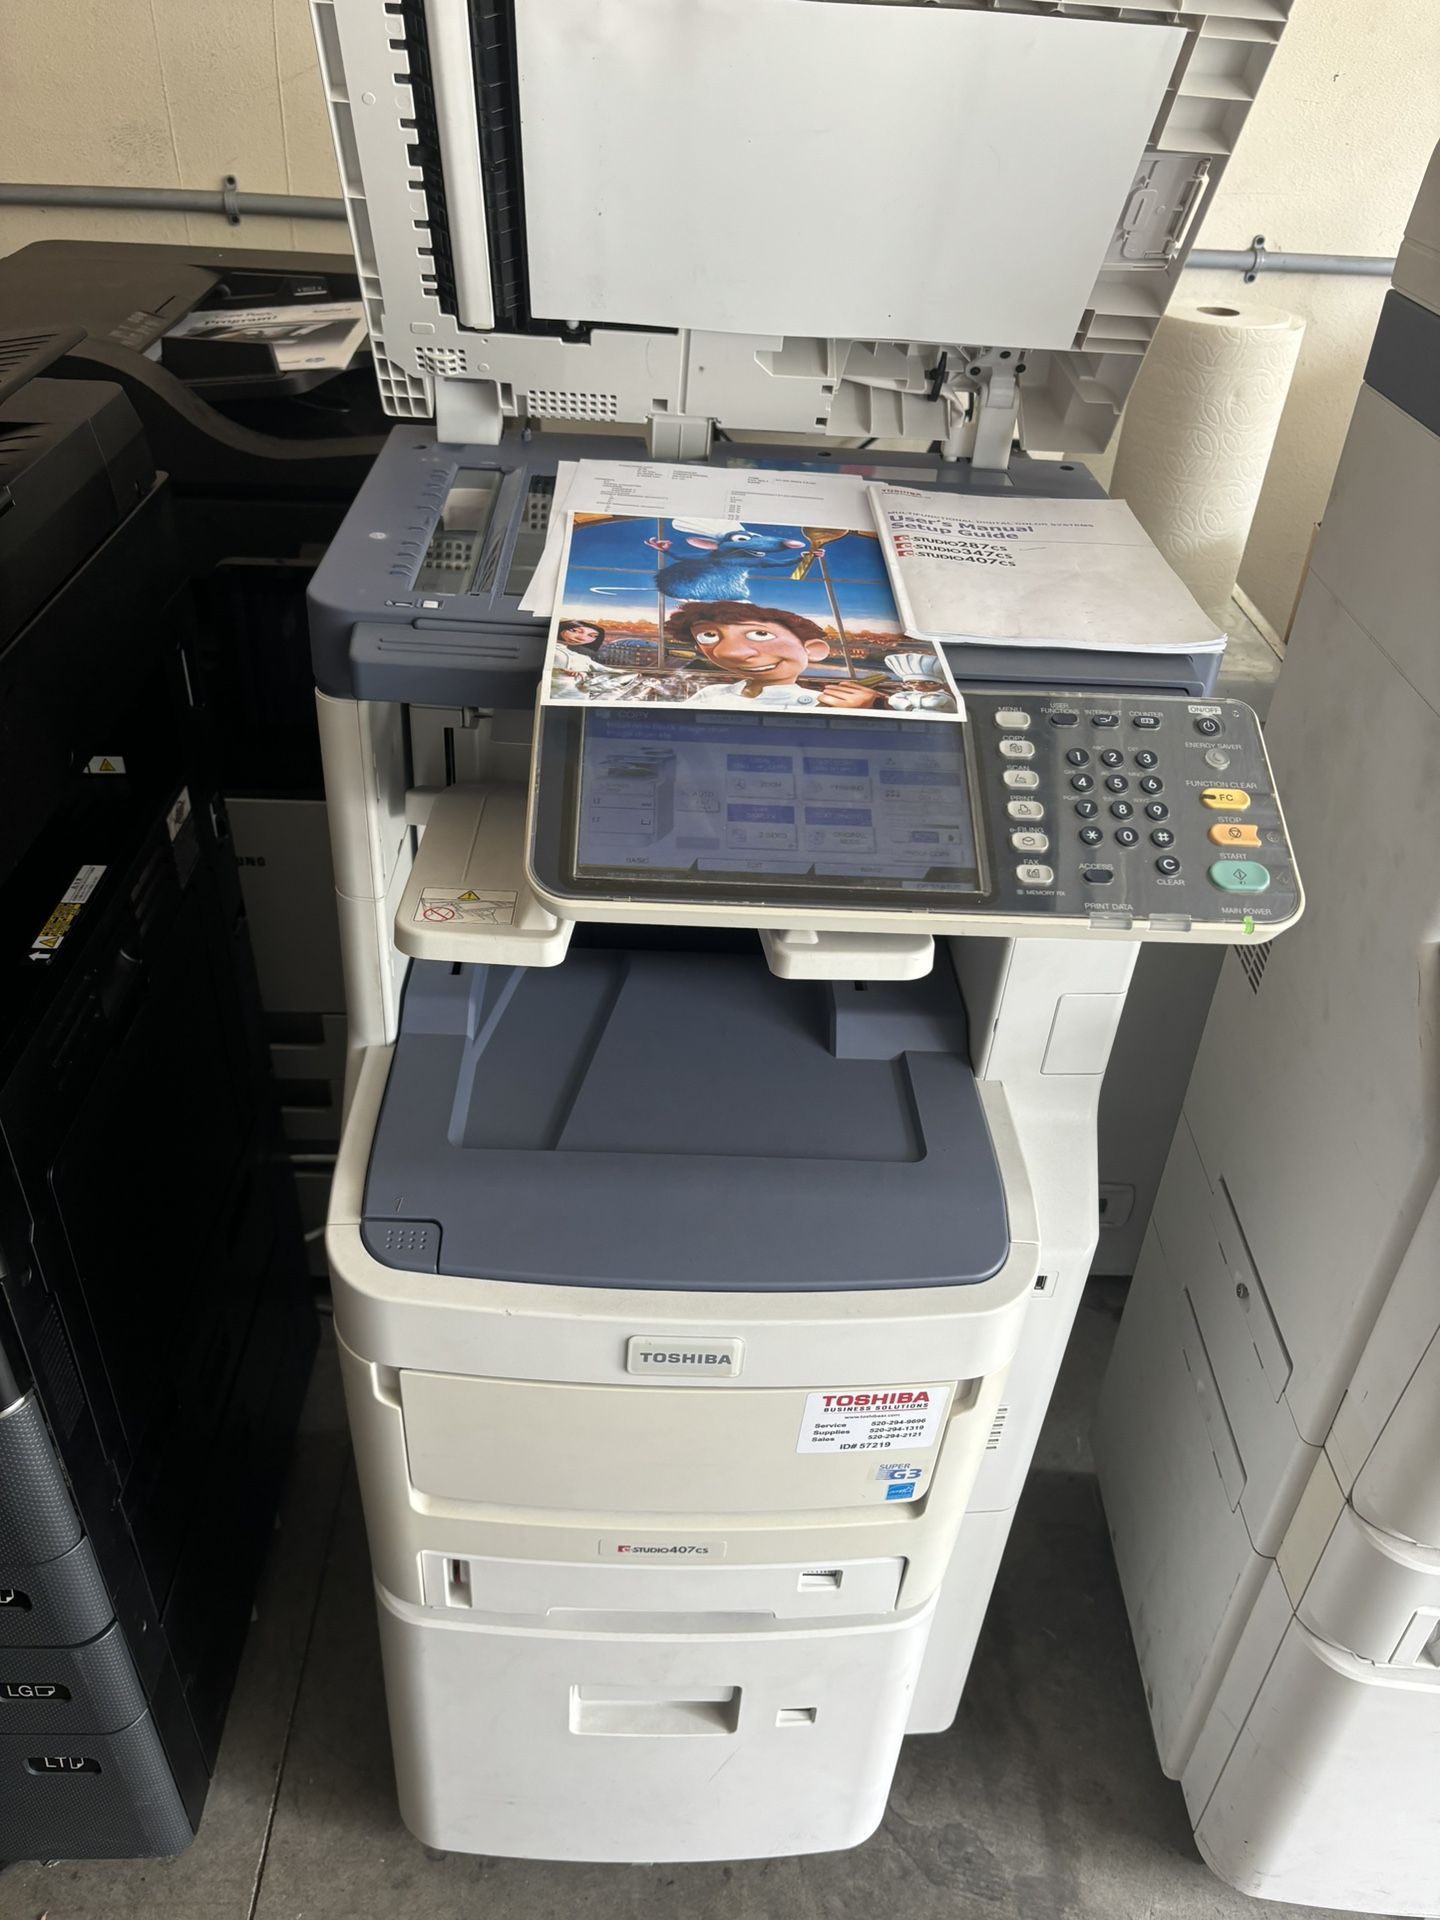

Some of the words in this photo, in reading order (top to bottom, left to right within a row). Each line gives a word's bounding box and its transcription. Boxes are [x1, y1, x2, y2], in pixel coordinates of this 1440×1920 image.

[889, 515, 952, 528] User's
[958, 523, 1034, 533] Manual
[891, 522, 952, 535] Setup
[958, 529, 1019, 540] Guide
[1076, 752, 1081, 761] 1
[1109, 753, 1117, 762] 2
[1143, 754, 1151, 763] 3
[1078, 777, 1087, 786] 4
[1114, 779, 1122, 788] 5
[1149, 780, 1157, 789] 6
[1186, 780, 1229, 788] FUNCTION
[1084, 804, 1091, 813] 7
[1119, 805, 1127, 814] 8
[1153, 806, 1162, 815] 9
[1123, 831, 1133, 841] 0
[1158, 832, 1170, 842] #
[1163, 860, 1176, 869] C
[640, 1352, 732, 1365] TOSHIBA
[823, 1391, 930, 1407] TOSHIBA
[824, 1405, 871, 1413] BUSINESS
[875, 1403, 929, 1411] SOLUTIONS
[813, 1429, 851, 1437] Supplies
[867, 1432, 922, 1440] 520-294-2121
[859, 1441, 891, 1449] 57219
[889, 1468, 922, 1480] G3
[7, 1685, 34, 1697] LG
[44, 1757, 67, 1768] LT
